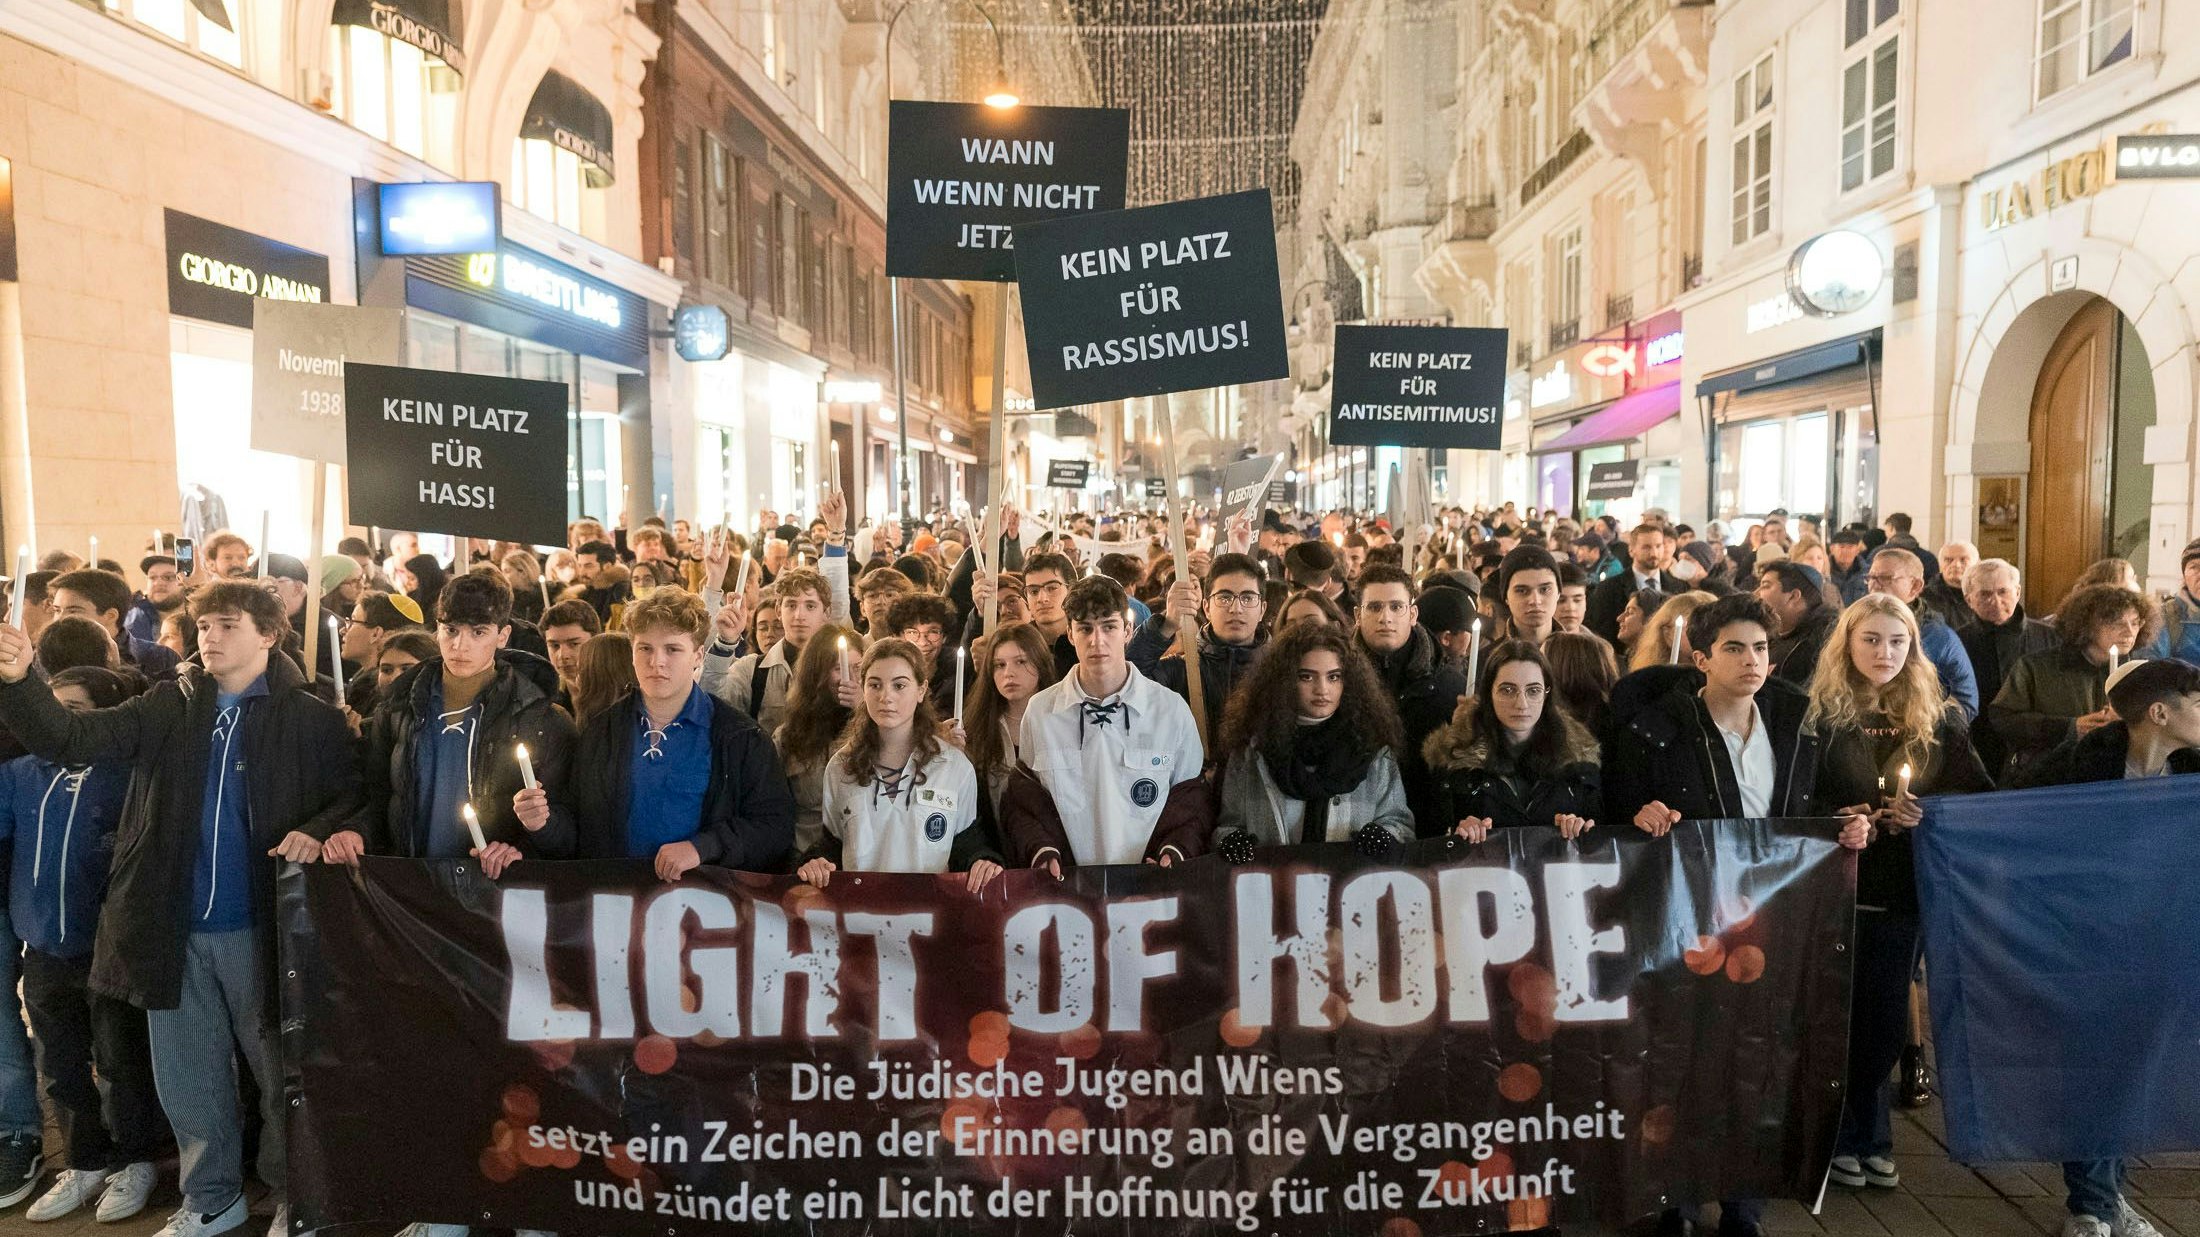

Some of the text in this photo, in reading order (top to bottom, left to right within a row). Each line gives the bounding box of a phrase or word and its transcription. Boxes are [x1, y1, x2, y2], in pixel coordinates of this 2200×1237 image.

[370, 10, 442, 57] GIORGIO
[961, 137, 1055, 166] WANN
[913, 178, 1101, 210] WENN NICHT
[957, 223, 1014, 250] JETZ
[1060, 230, 1232, 281] KEIN PLATZ
[180, 252, 258, 295] GIORGIO
[1120, 282, 1182, 318] FÜR
[278, 348, 345, 377] Novem
[1062, 320, 1249, 371] RASSISMUS!
[1369, 351, 1472, 370] KEIN PLATZ
[300, 389, 341, 415] 1938
[1400, 375, 1437, 396] FÜR
[383, 397, 530, 434] KEIN PLATZ
[1337, 403, 1497, 424] ANTISEMITIMUS!
[431, 438, 483, 470] FÜR
[418, 480, 495, 510] HASS!
[502, 862, 1629, 1041] LIGHT OF HOPE
[791, 1055, 1344, 1109] Die Jüdische Jugend Wiens
[528, 1100, 1626, 1169] setzt ein Zeichen der Erinnerung an die Vergangenheit
[574, 1157, 1576, 1232] und zündet ein Licht der Hoffnung für die Zukunft
